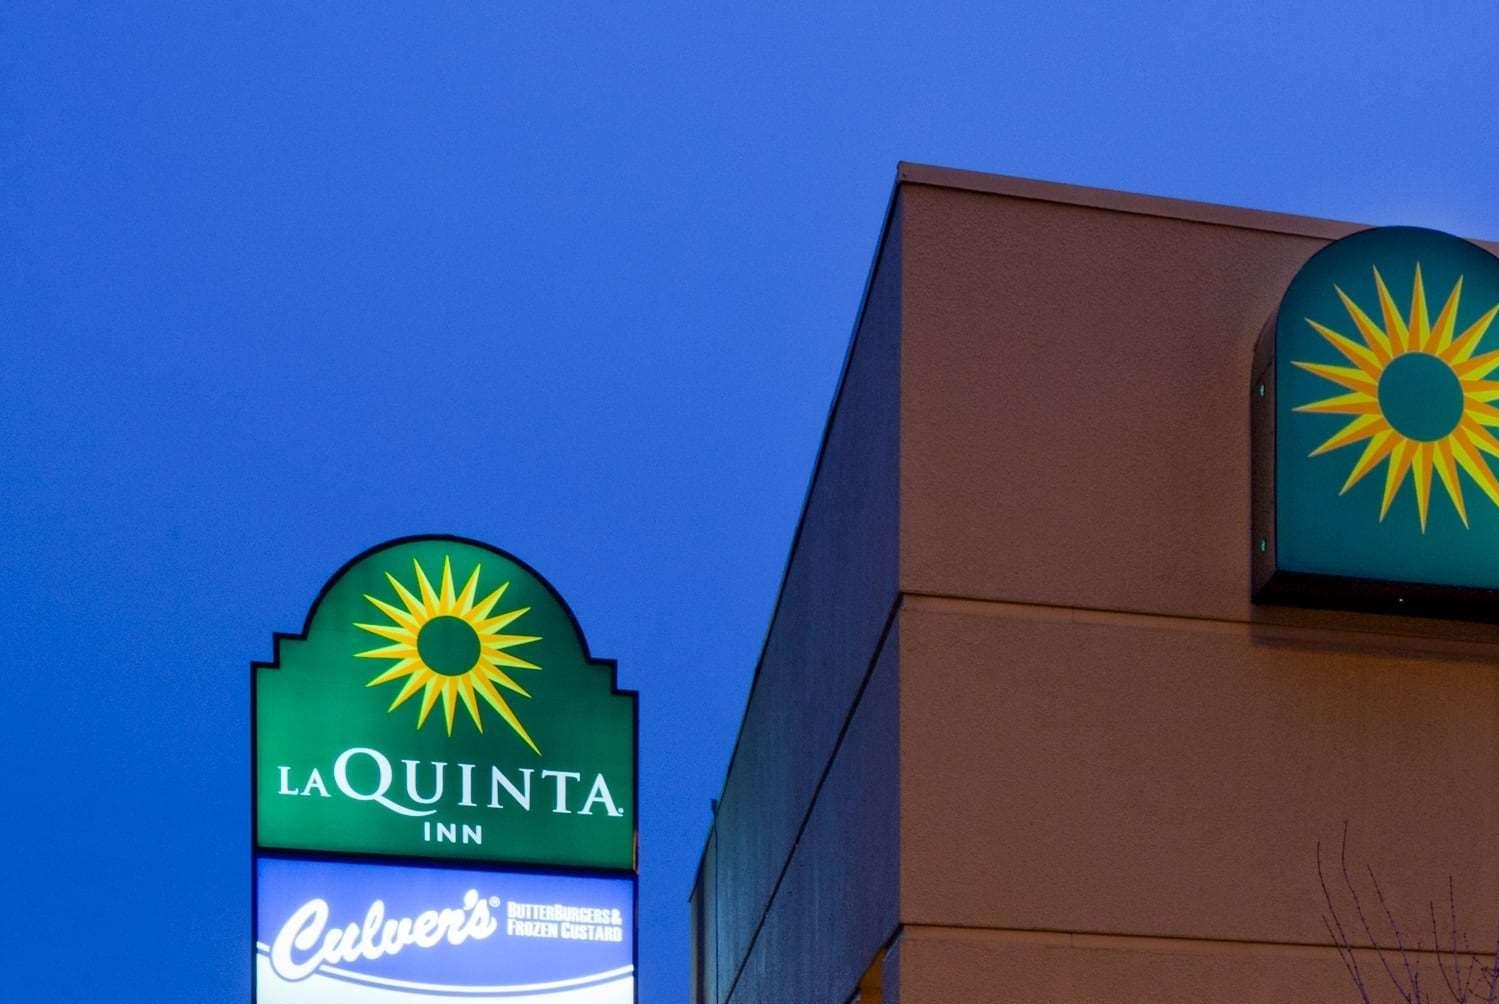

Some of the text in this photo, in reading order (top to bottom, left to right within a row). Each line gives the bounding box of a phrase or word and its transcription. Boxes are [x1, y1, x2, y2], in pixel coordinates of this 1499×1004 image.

[277, 747, 623, 845] LA QUINTA INN
[271, 889, 498, 980] Culver's
